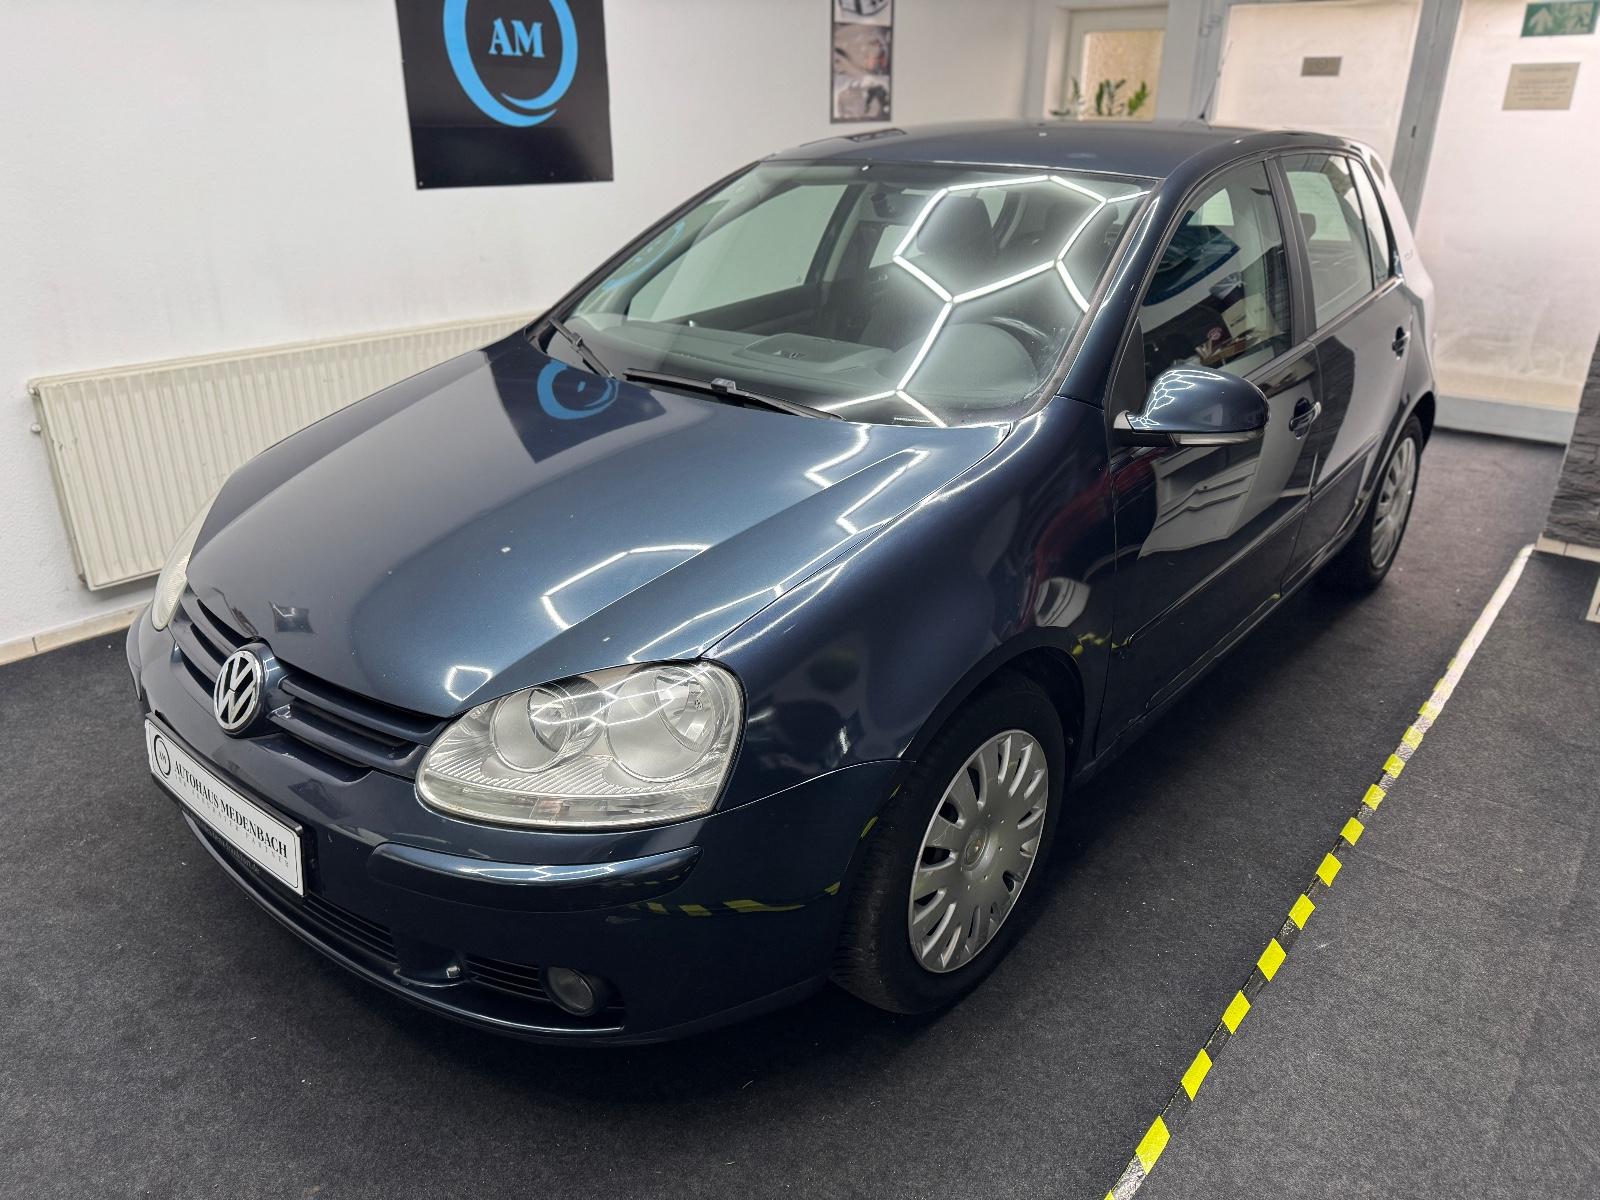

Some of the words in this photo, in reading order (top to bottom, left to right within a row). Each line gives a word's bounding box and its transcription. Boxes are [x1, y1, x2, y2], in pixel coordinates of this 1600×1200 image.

[488, 17, 545, 58] AM
[174, 760, 219, 809] AUTOHAUS
[219, 798, 288, 859] MEDENBACH
